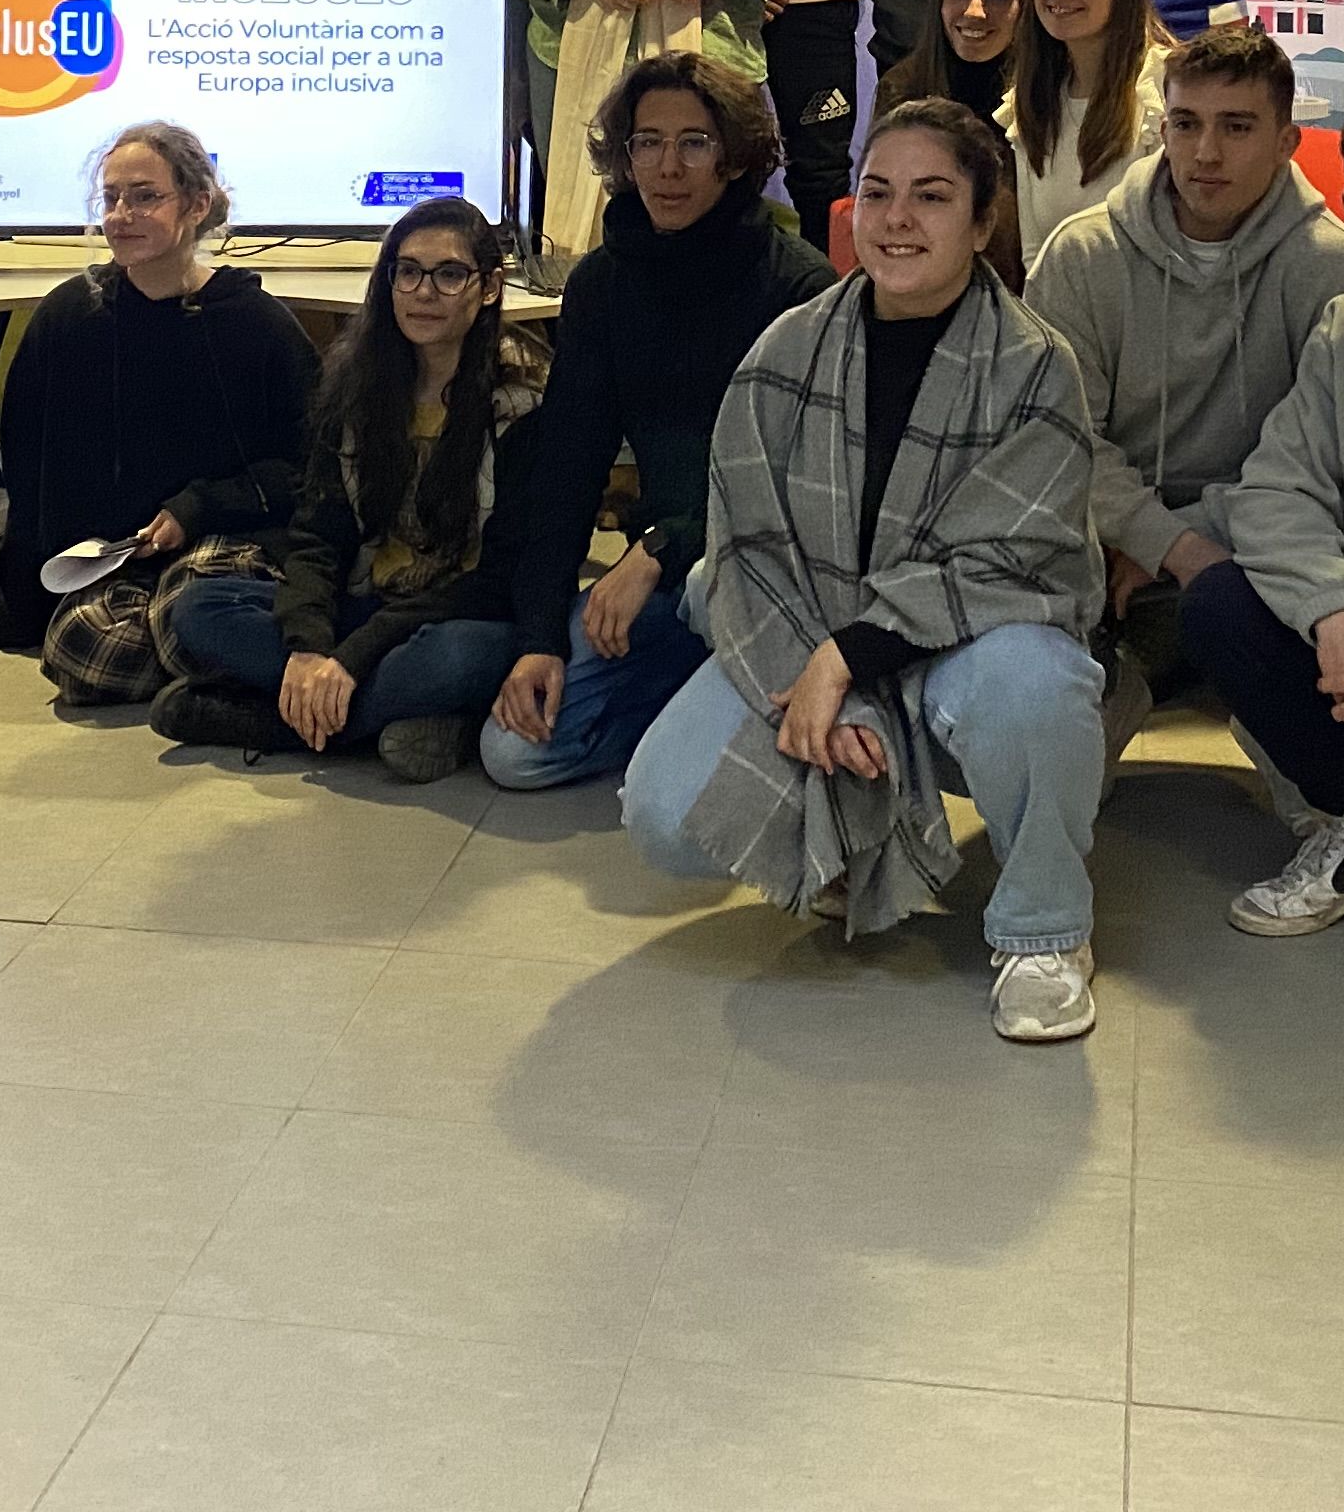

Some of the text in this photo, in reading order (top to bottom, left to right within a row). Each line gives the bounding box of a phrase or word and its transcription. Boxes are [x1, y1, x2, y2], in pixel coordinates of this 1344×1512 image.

[148, 19, 444, 40] L'Acció Voluntària com a
[148, 46, 443, 70] resposta social per a una
[198, 73, 394, 95] Europa inclusiva
